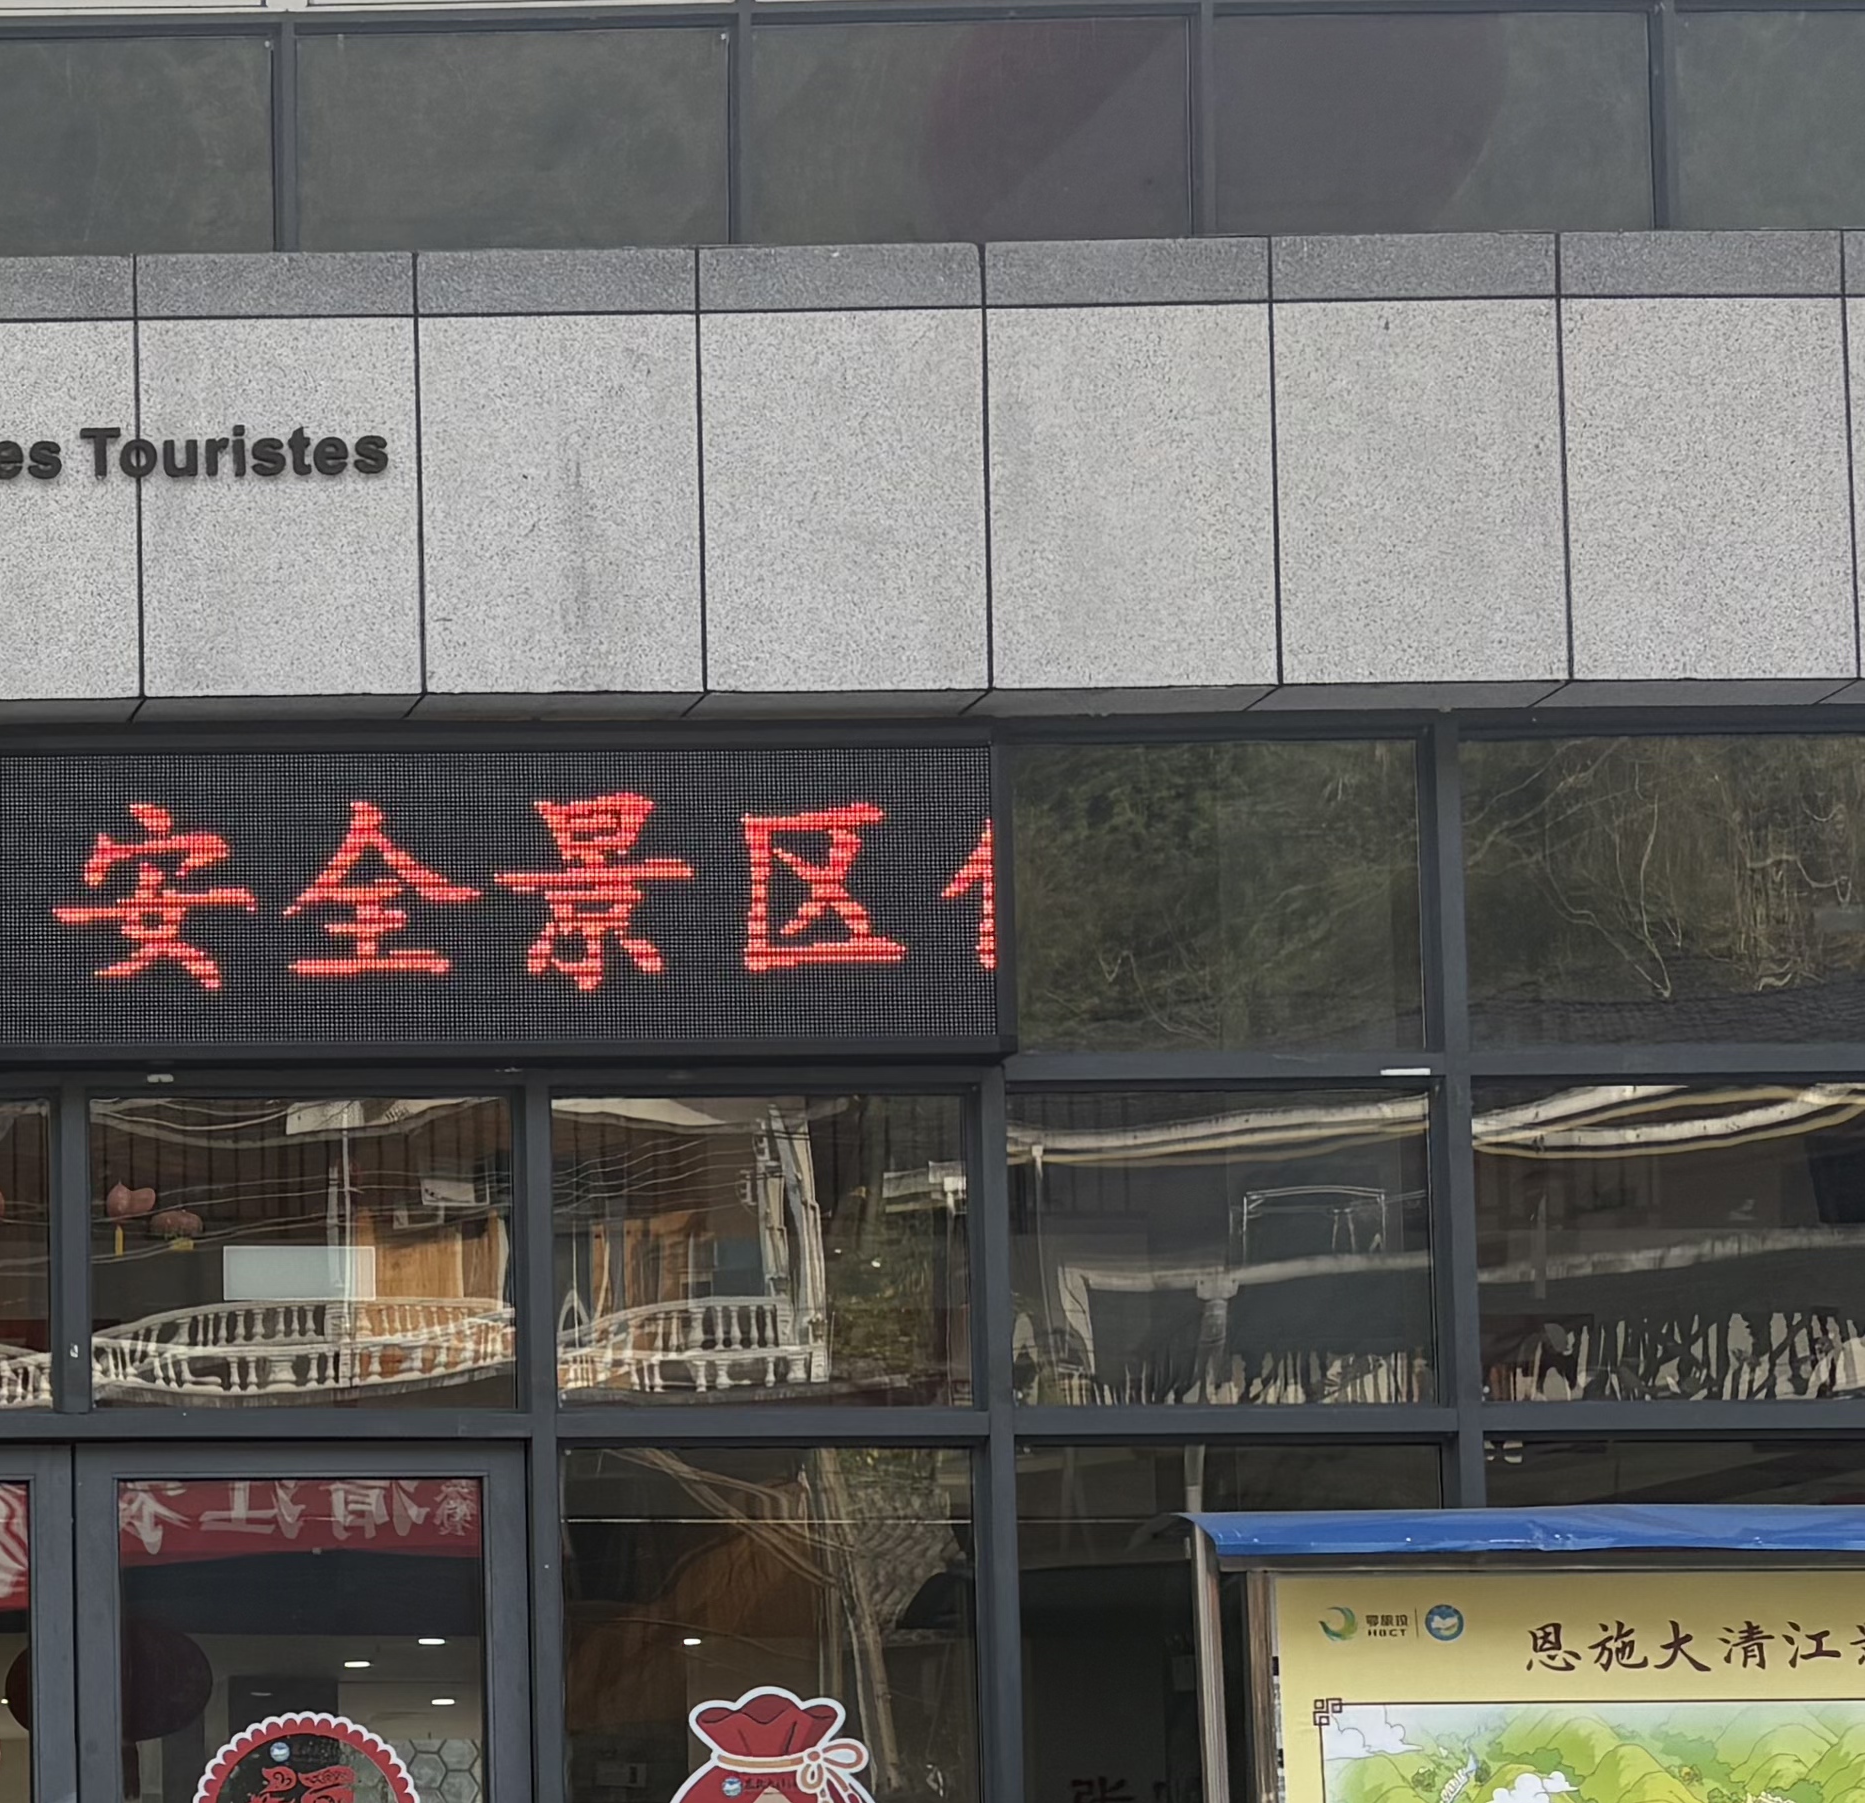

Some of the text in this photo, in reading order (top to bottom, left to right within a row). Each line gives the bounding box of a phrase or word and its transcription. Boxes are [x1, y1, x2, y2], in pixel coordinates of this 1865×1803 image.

[80, 425, 390, 477] Touristes
[1527, 1620, 1865, 1673] 恩施大清江
